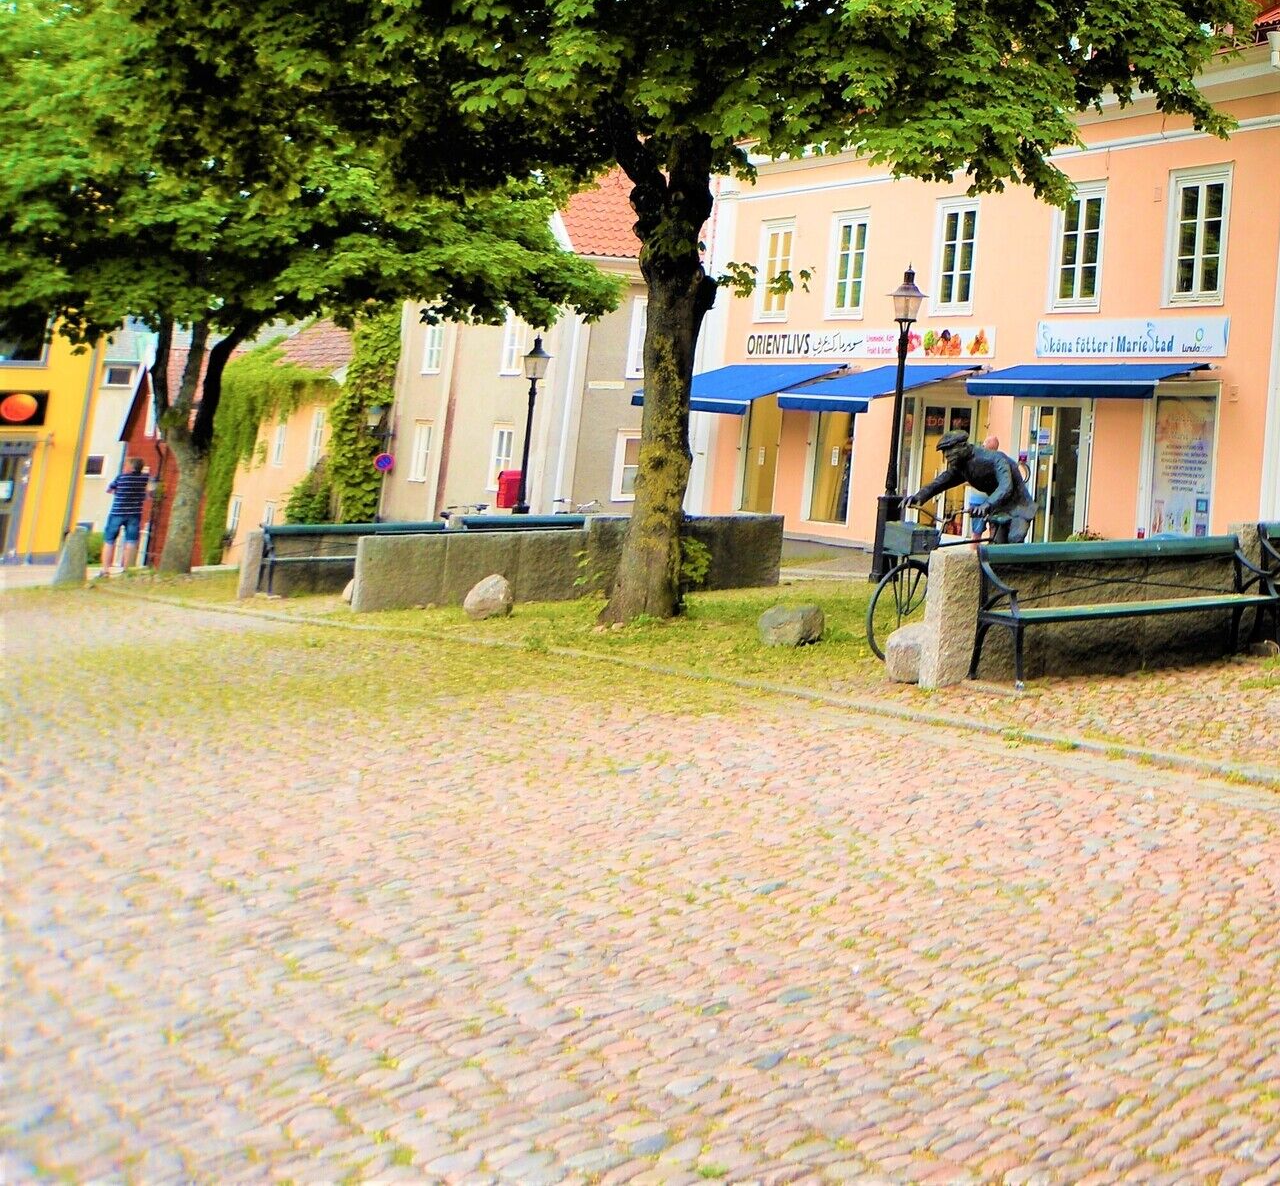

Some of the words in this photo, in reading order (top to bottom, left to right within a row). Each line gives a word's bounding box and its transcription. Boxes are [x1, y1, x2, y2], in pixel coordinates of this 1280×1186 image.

[748, 333, 811, 355] ORIENTLIVS
[1042, 328, 1073, 353] Sköna
[1076, 336, 1109, 353] fötter
[1110, 336, 1114, 353] i
[1116, 325, 1175, 353] MarieStad
